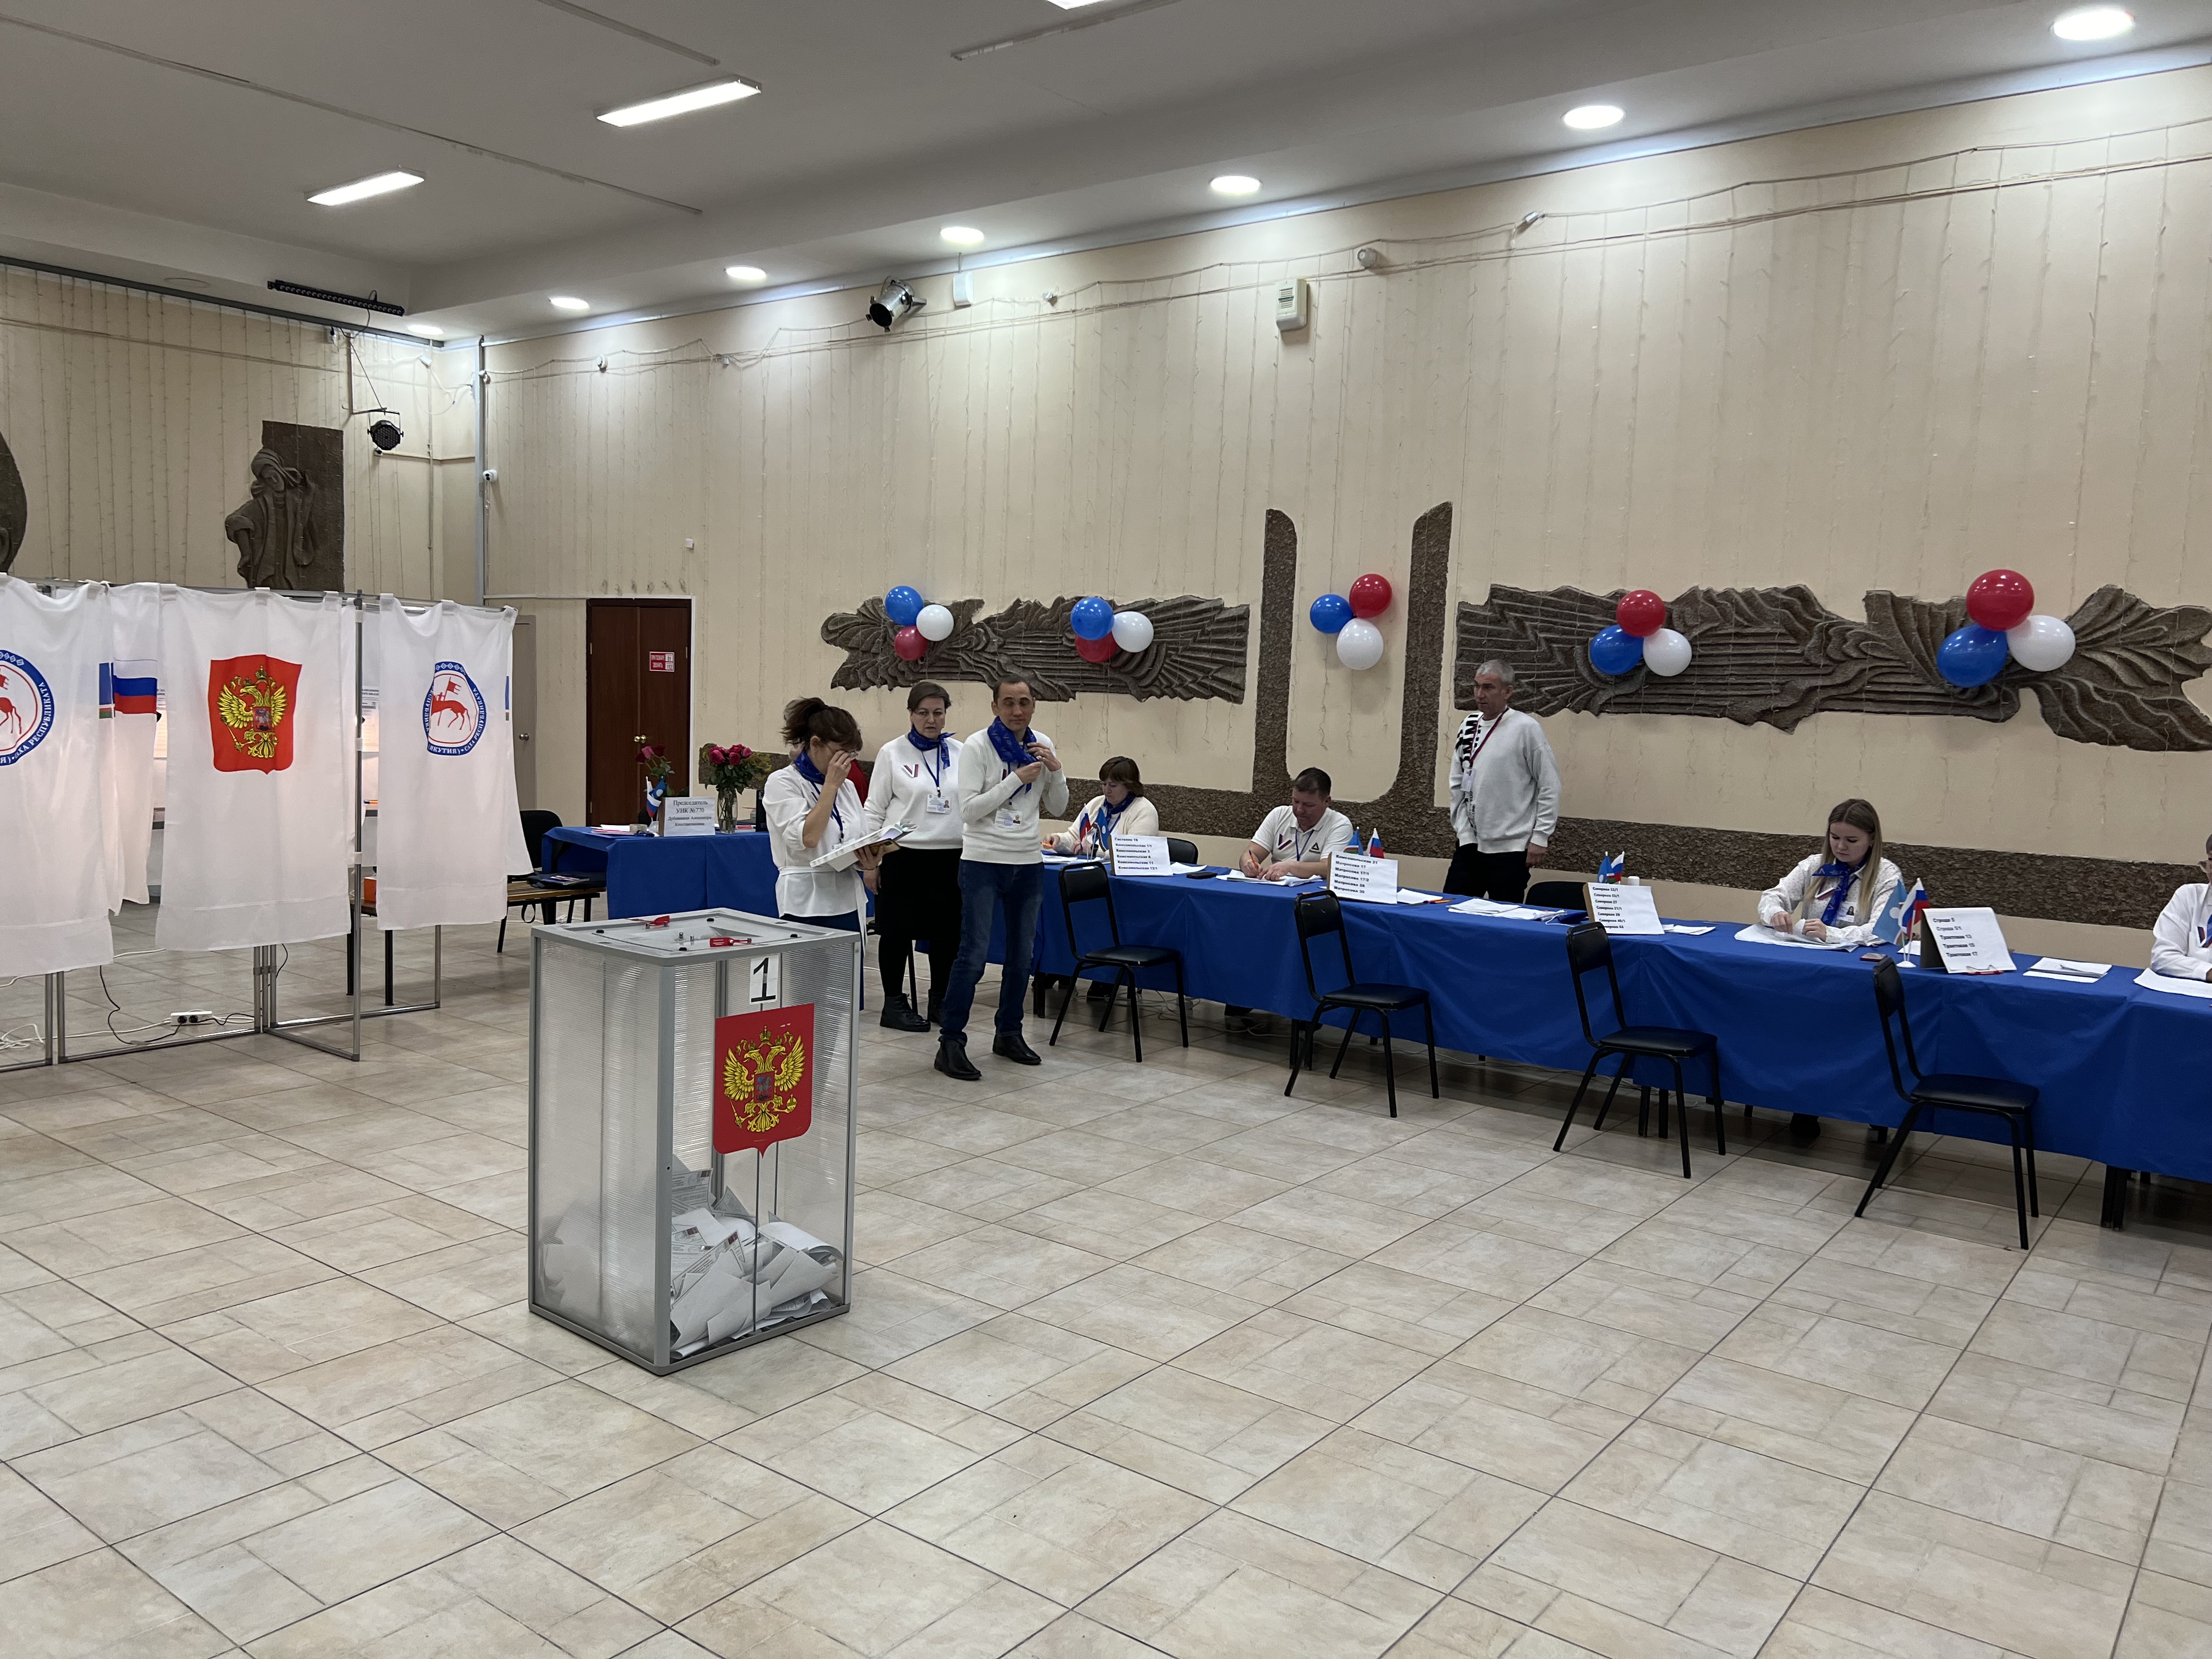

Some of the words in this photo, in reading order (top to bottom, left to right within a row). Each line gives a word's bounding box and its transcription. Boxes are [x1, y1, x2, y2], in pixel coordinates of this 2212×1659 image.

[28, 681, 52, 746] РЕСПУБЛИКАТА
[472, 687, 484, 740] РЕСПУБЛИКАТА
[1336, 854, 1372, 864] Комсомольская
[751, 957, 776, 1002] 1
